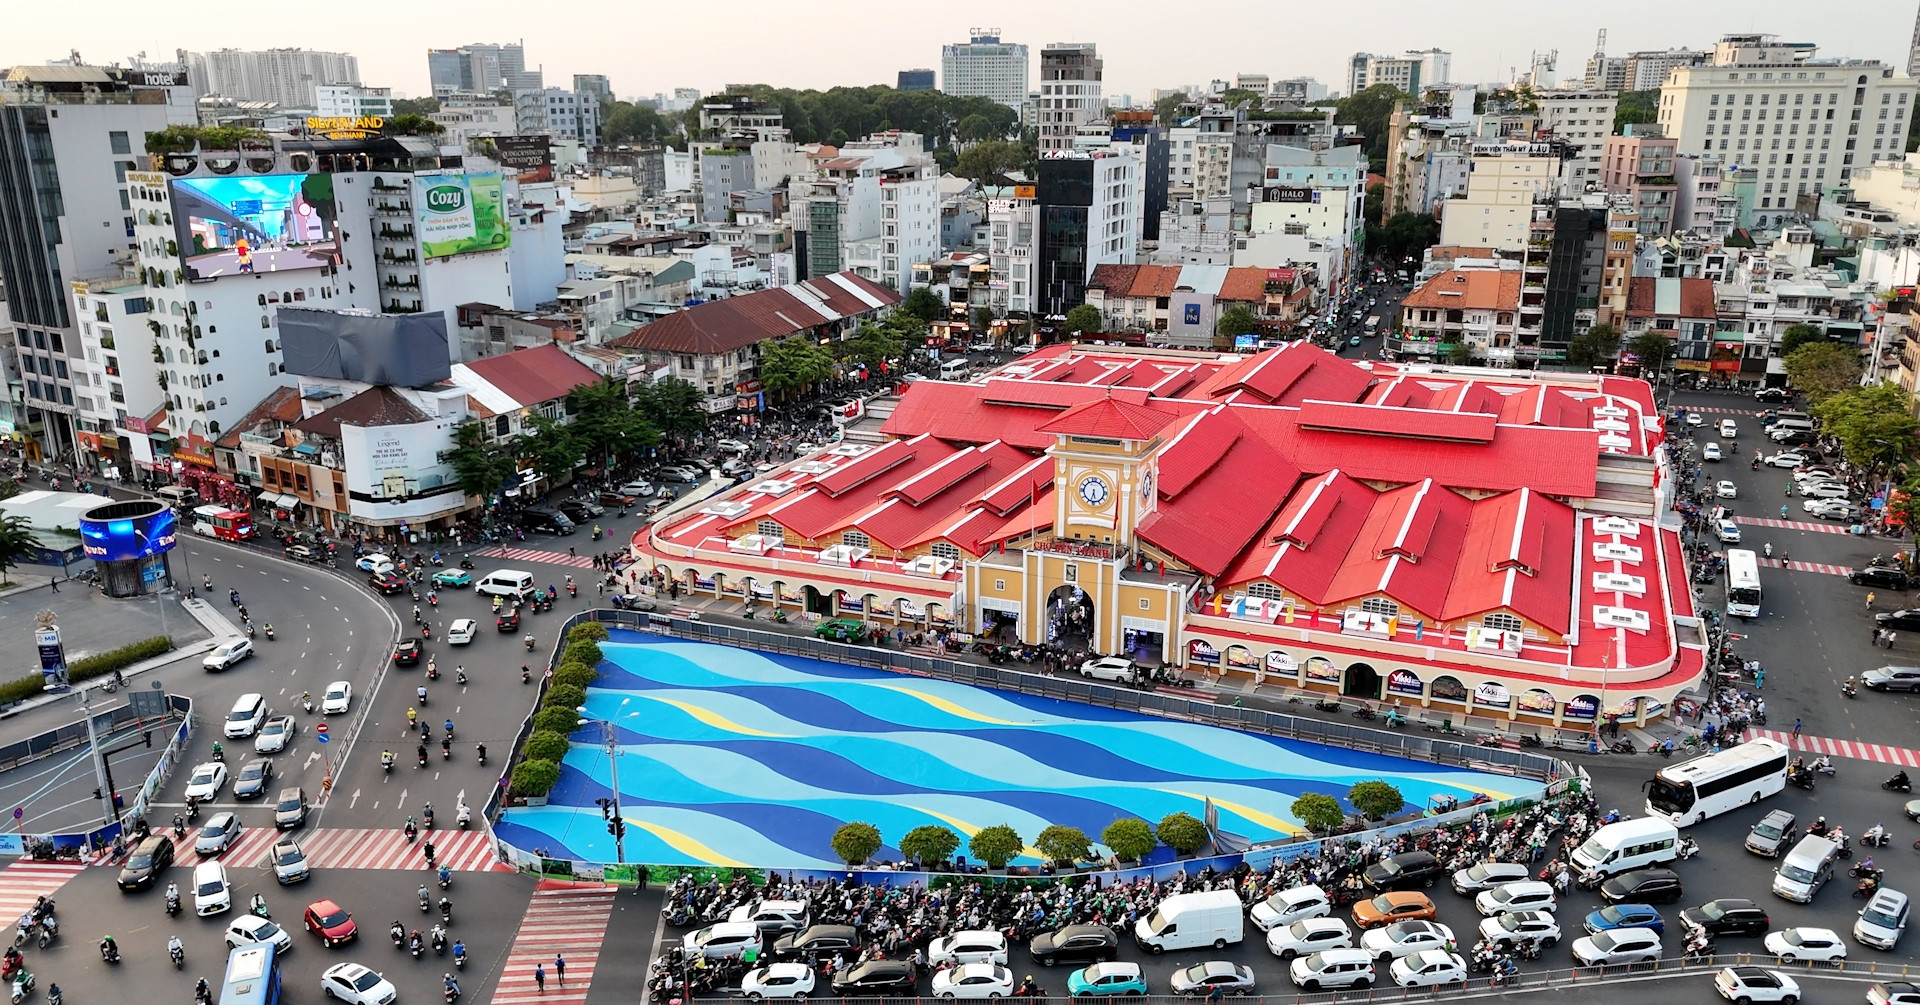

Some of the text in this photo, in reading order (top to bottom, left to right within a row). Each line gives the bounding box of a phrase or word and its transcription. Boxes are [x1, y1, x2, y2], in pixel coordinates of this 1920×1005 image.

[143, 72, 175, 86] hotel
[307, 116, 384, 129] SILVERLAND
[527, 155, 543, 166] 2025
[429, 190, 461, 208] Cozy
[1281, 190, 1305, 198] HALO
[1186, 314, 1198, 322] PNJ
[377, 439, 401, 448] Legend
[1193, 641, 1211, 653] Vikki
[1269, 654, 1288, 665] Vikki
[1392, 672, 1412, 684] Vikki
[1479, 685, 1498, 696] Vikki
[1570, 698, 1587, 708] Vikki
